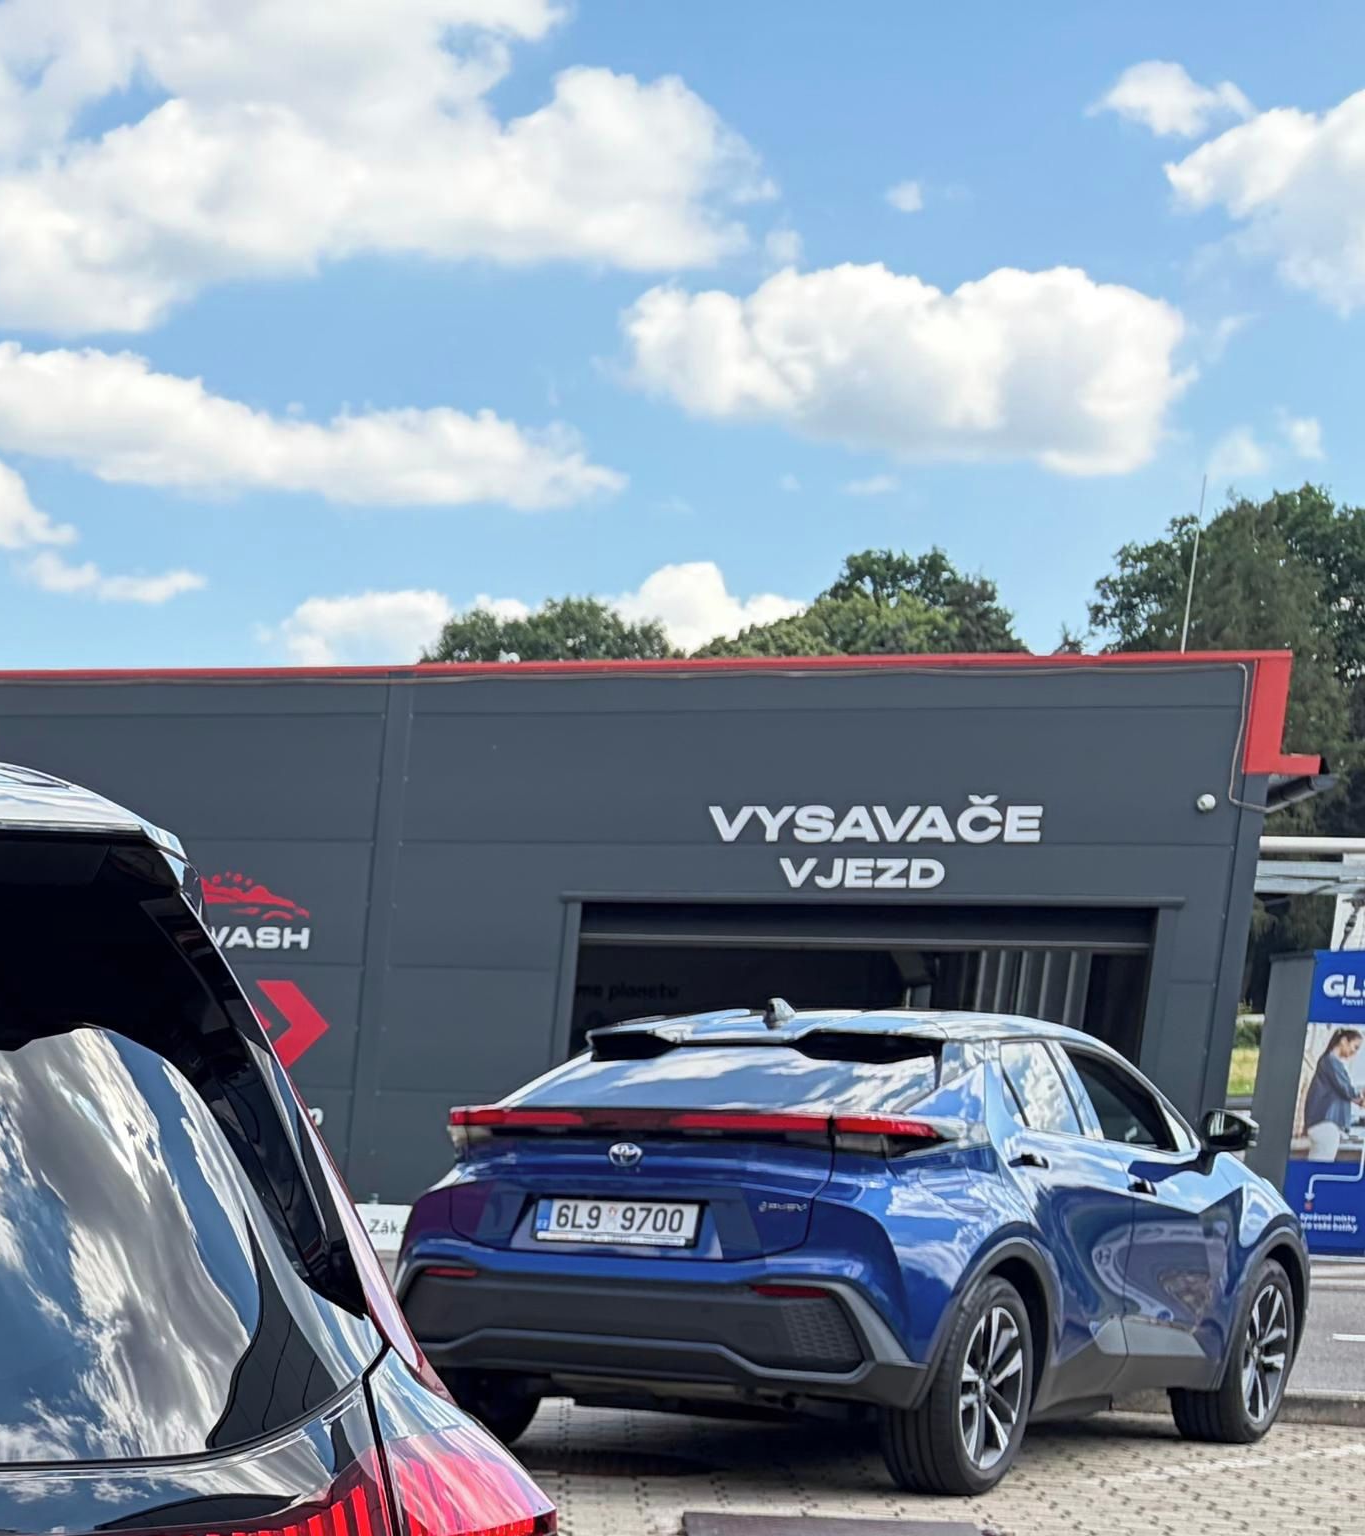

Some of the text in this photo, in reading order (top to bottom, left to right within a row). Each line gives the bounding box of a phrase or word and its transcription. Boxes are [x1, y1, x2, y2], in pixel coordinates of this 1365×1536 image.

[708, 794, 1044, 844] VYSAVAČE
[779, 857, 946, 889] VJEZD
[1322, 974, 1365, 998] GL
[556, 1204, 602, 1230] 6L9
[619, 1206, 685, 1234] 9700
